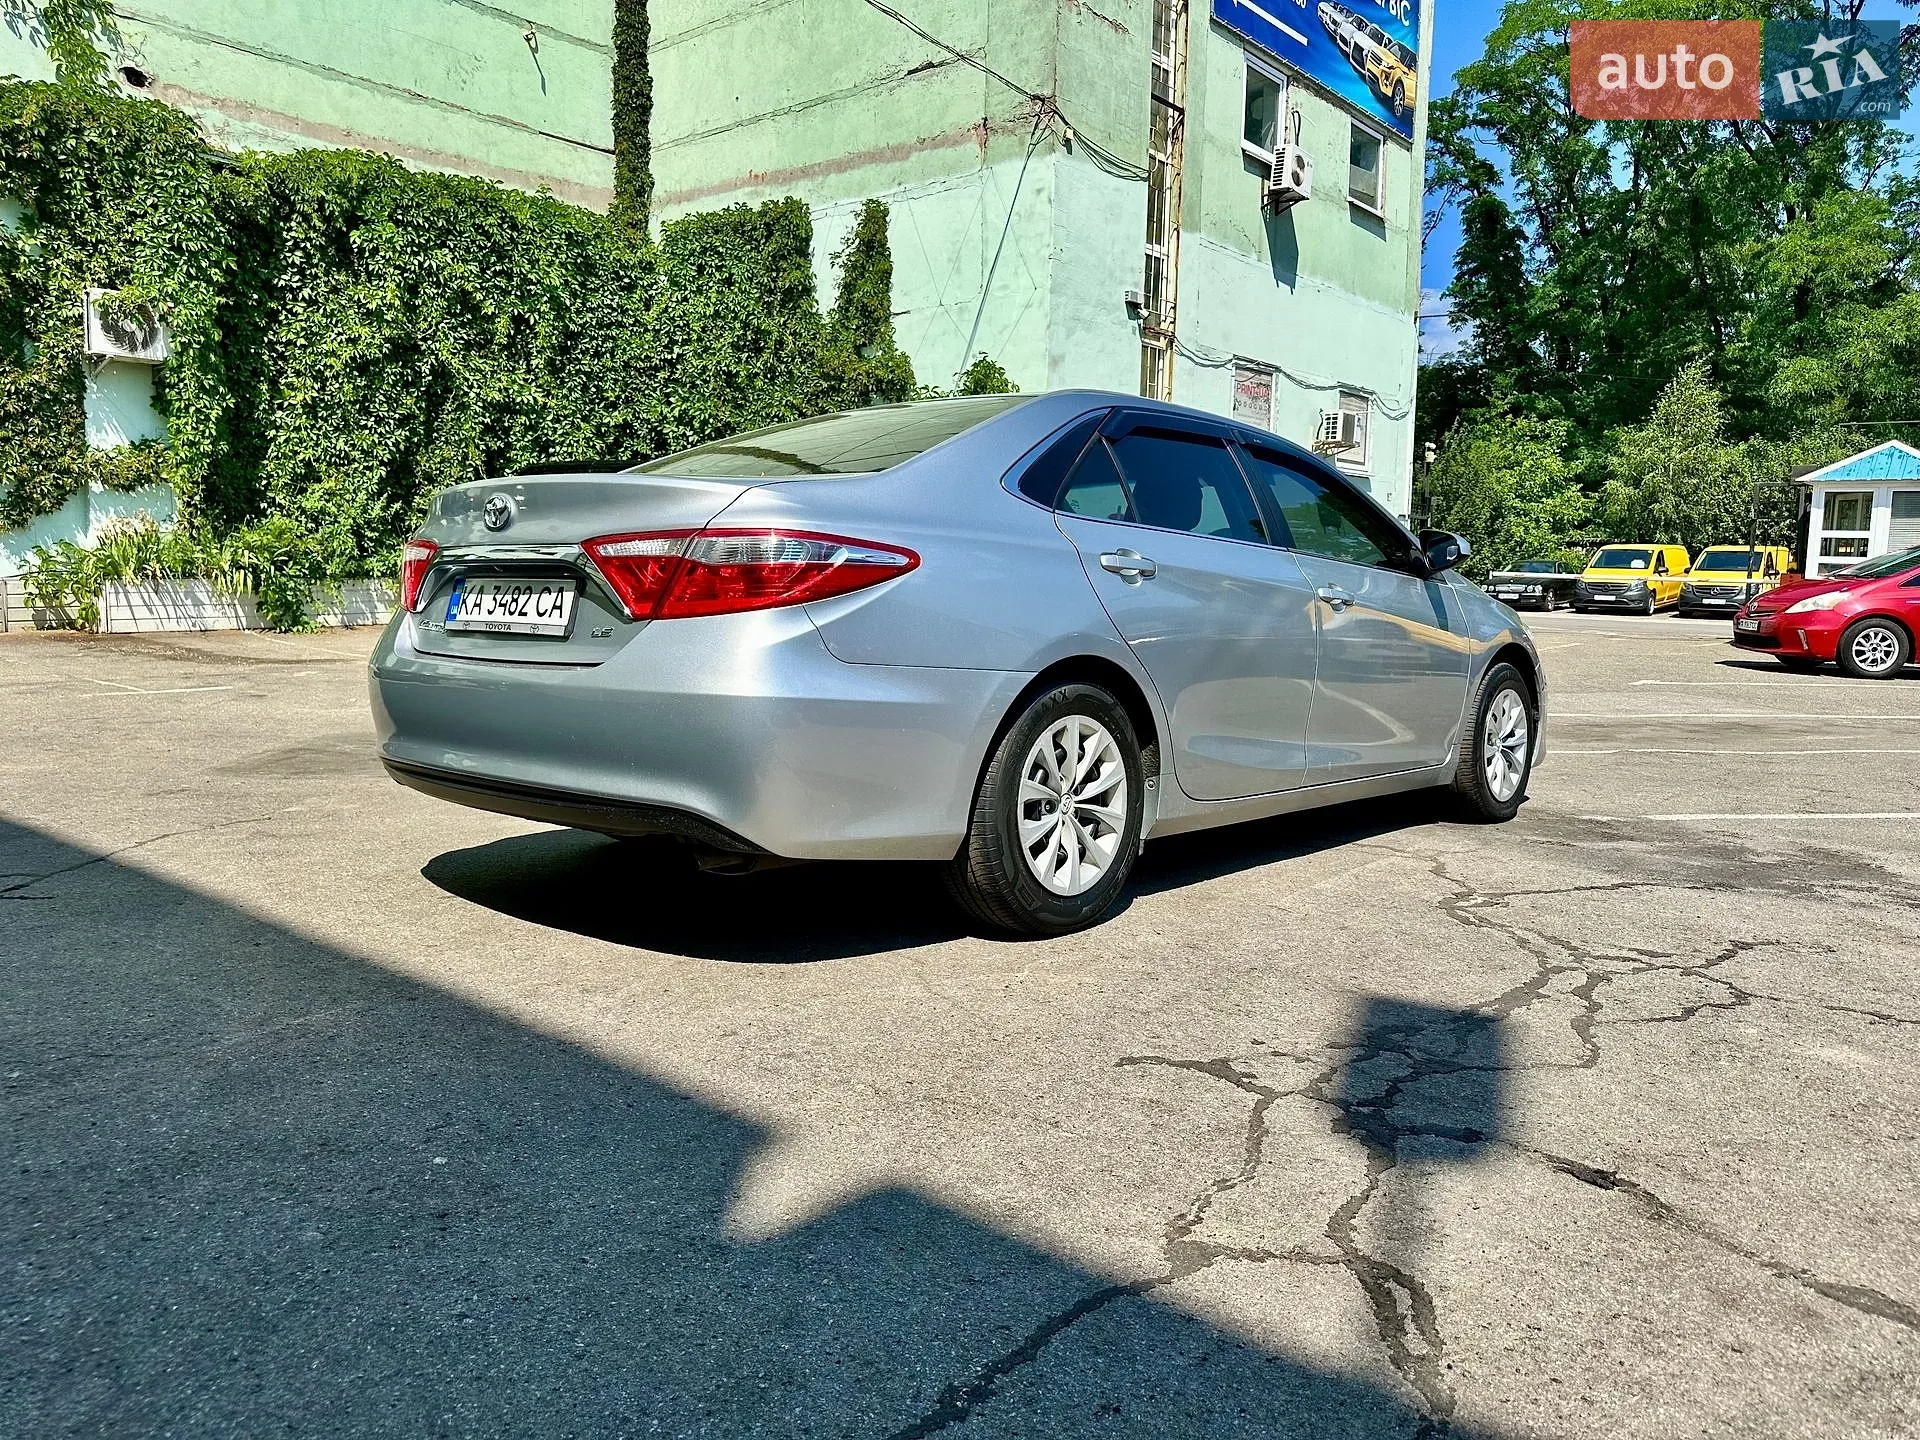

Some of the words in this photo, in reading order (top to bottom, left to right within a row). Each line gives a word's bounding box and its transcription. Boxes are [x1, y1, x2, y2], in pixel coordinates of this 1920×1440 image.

[459, 585, 485, 615] KA
[487, 585, 533, 616] 3482
[536, 586, 565, 618] CA
[485, 623, 511, 631] TOYOTA
[591, 627, 614, 638] LE
